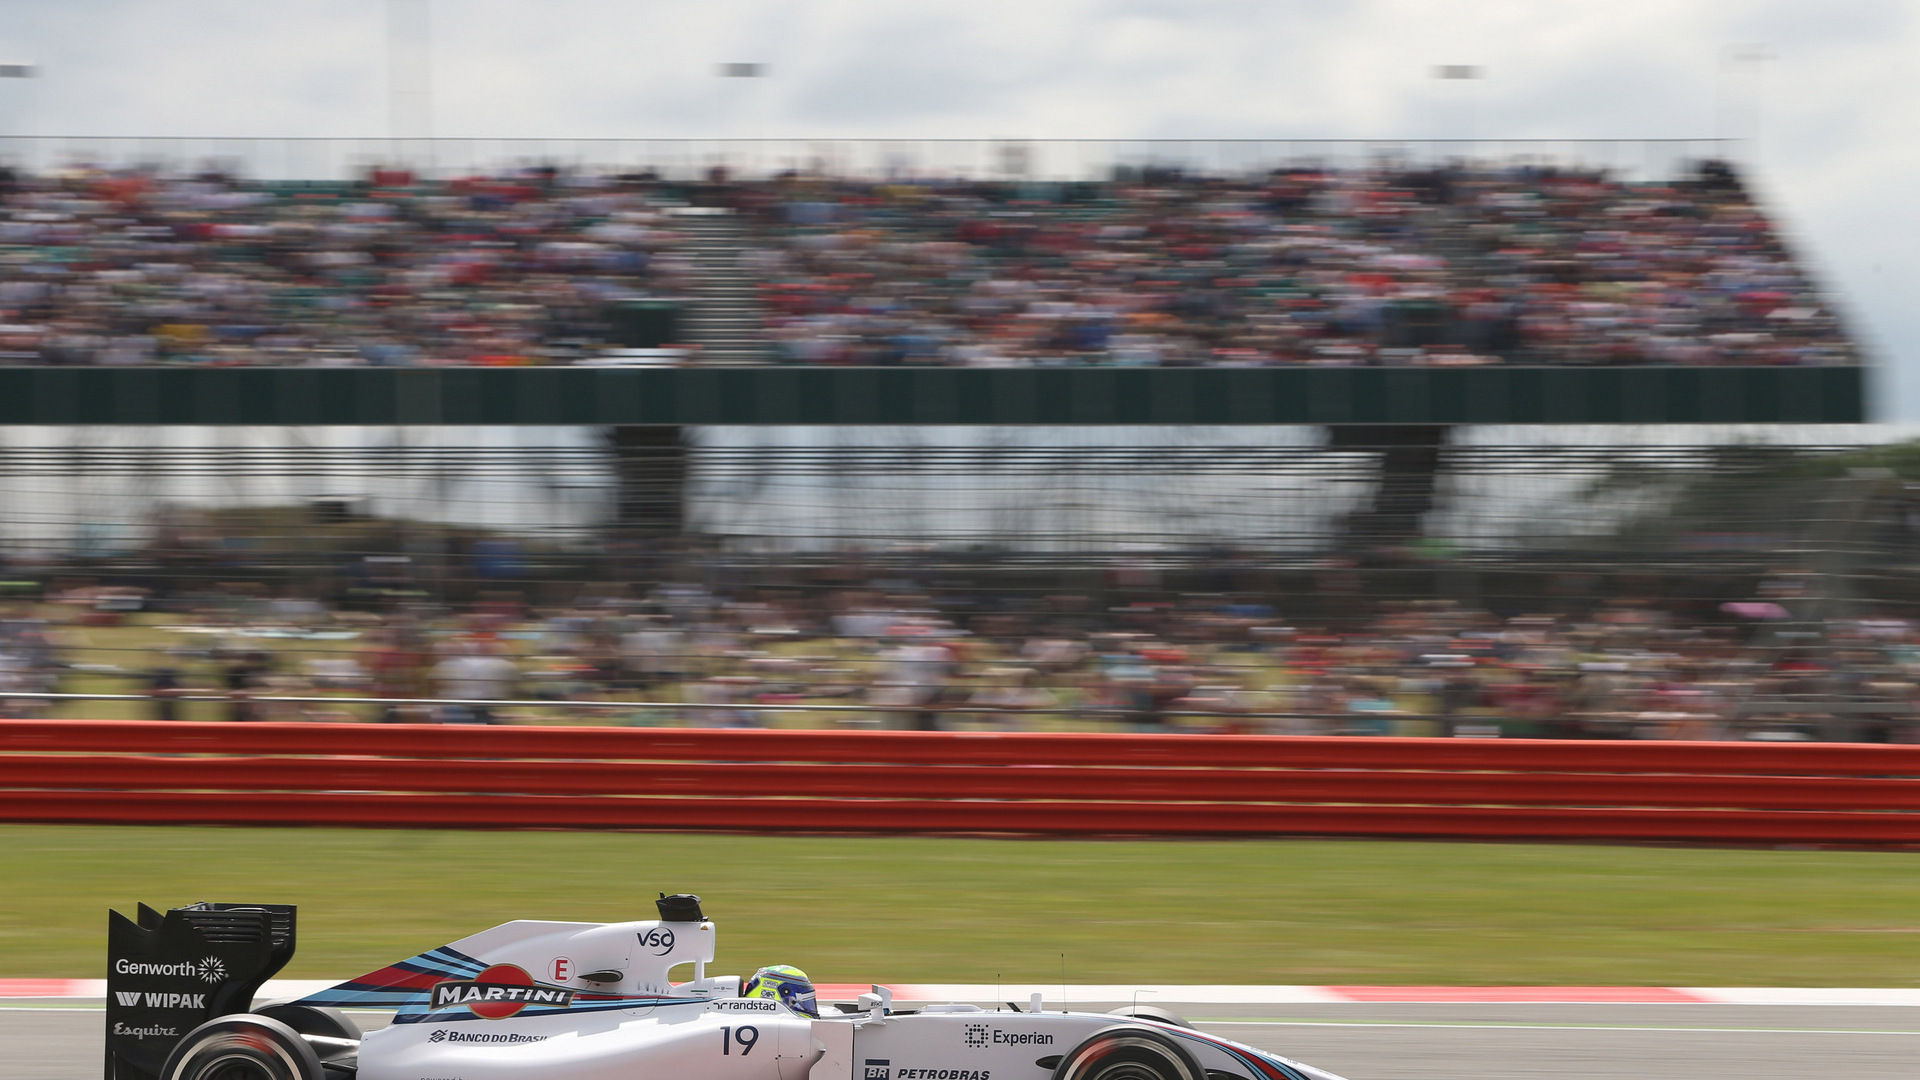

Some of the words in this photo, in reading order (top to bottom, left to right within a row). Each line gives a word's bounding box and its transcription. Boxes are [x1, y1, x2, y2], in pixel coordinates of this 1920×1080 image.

[115, 958, 196, 976] Genworth
[554, 959, 568, 980] E
[144, 992, 206, 1009] WIPAK
[438, 986, 566, 1005] MARTINI
[728, 1001, 777, 1011] randstad
[113, 1022, 179, 1040] Esquire
[448, 1031, 490, 1043] BANCO
[491, 1034, 508, 1043] DO
[993, 1029, 1053, 1046] Experian
[720, 1025, 759, 1056] 19
[866, 1068, 888, 1079] BR
[897, 1068, 990, 1080] PETROBRAS
